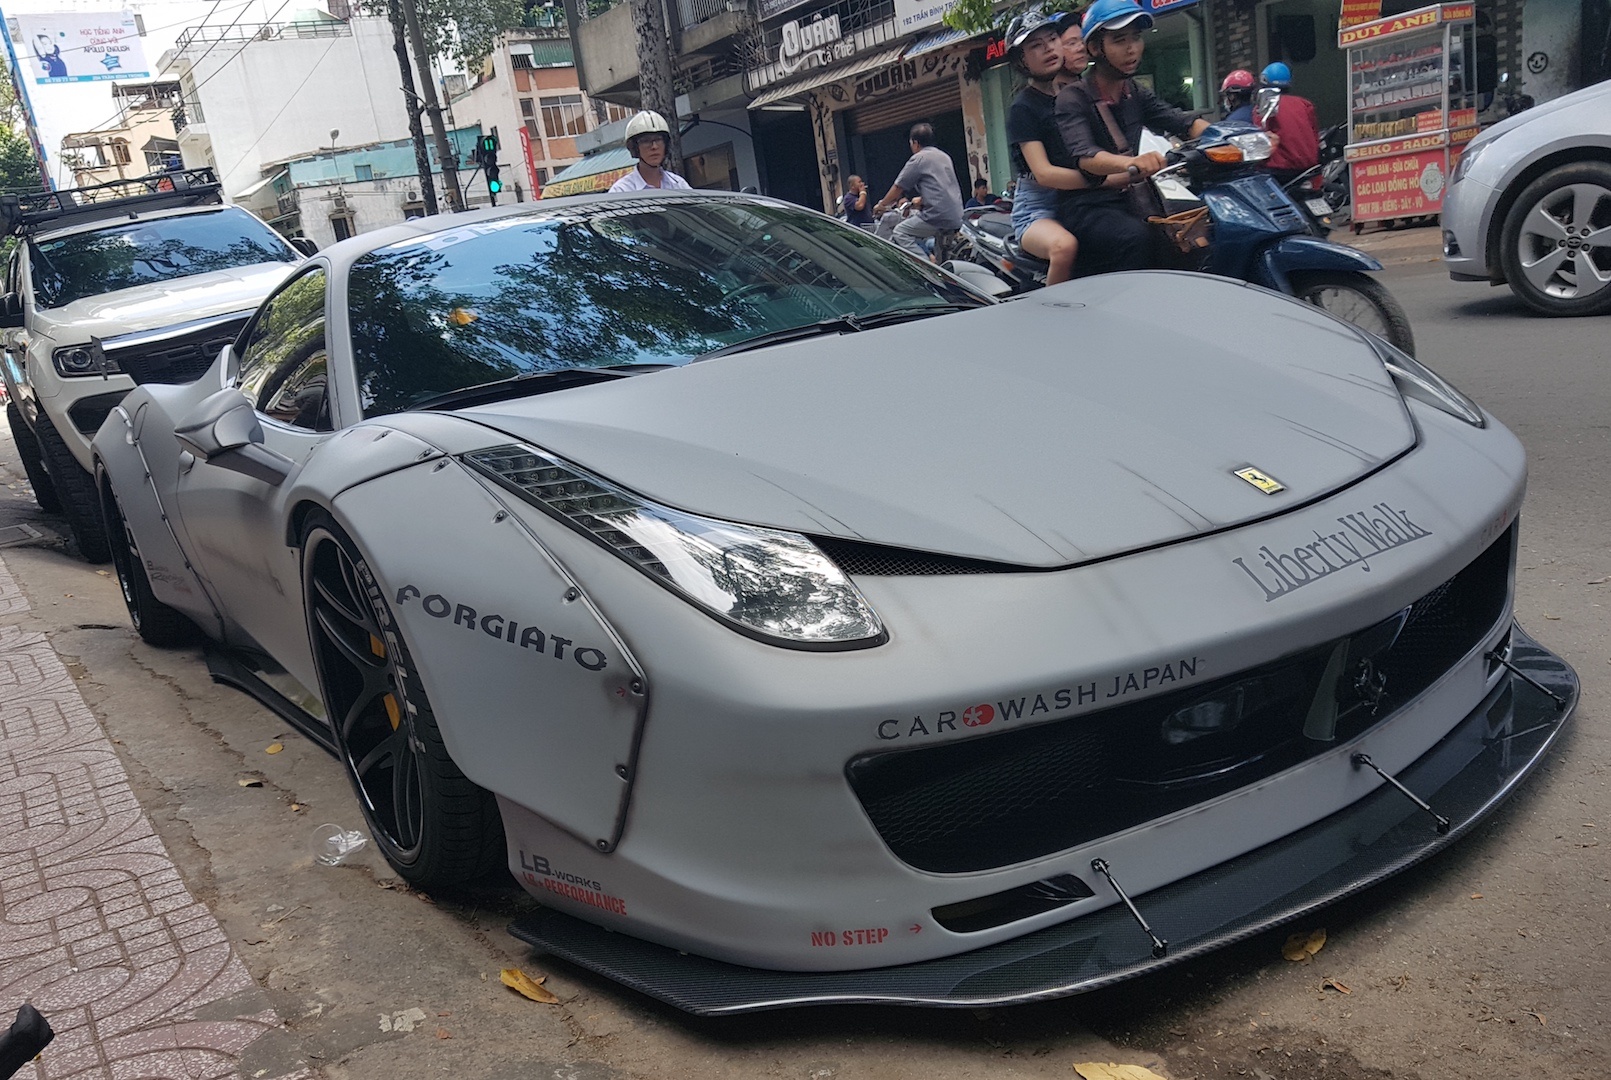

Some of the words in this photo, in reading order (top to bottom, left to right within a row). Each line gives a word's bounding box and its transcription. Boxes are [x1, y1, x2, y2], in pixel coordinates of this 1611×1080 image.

[1342, 24, 1385, 43] DUY
[1389, 11, 1437, 32] ANH
[1351, 144, 1391, 157] SEIKO
[1403, 136, 1440, 150] RADO
[1452, 129, 1478, 140] OMEGA
[395, 584, 608, 671] FORGIATO
[877, 710, 957, 740] CAR
[997, 682, 1097, 722] WASH
[1106, 656, 1199, 699] JAPAN
[811, 931, 836, 947] NO
[842, 928, 889, 946] STEP
